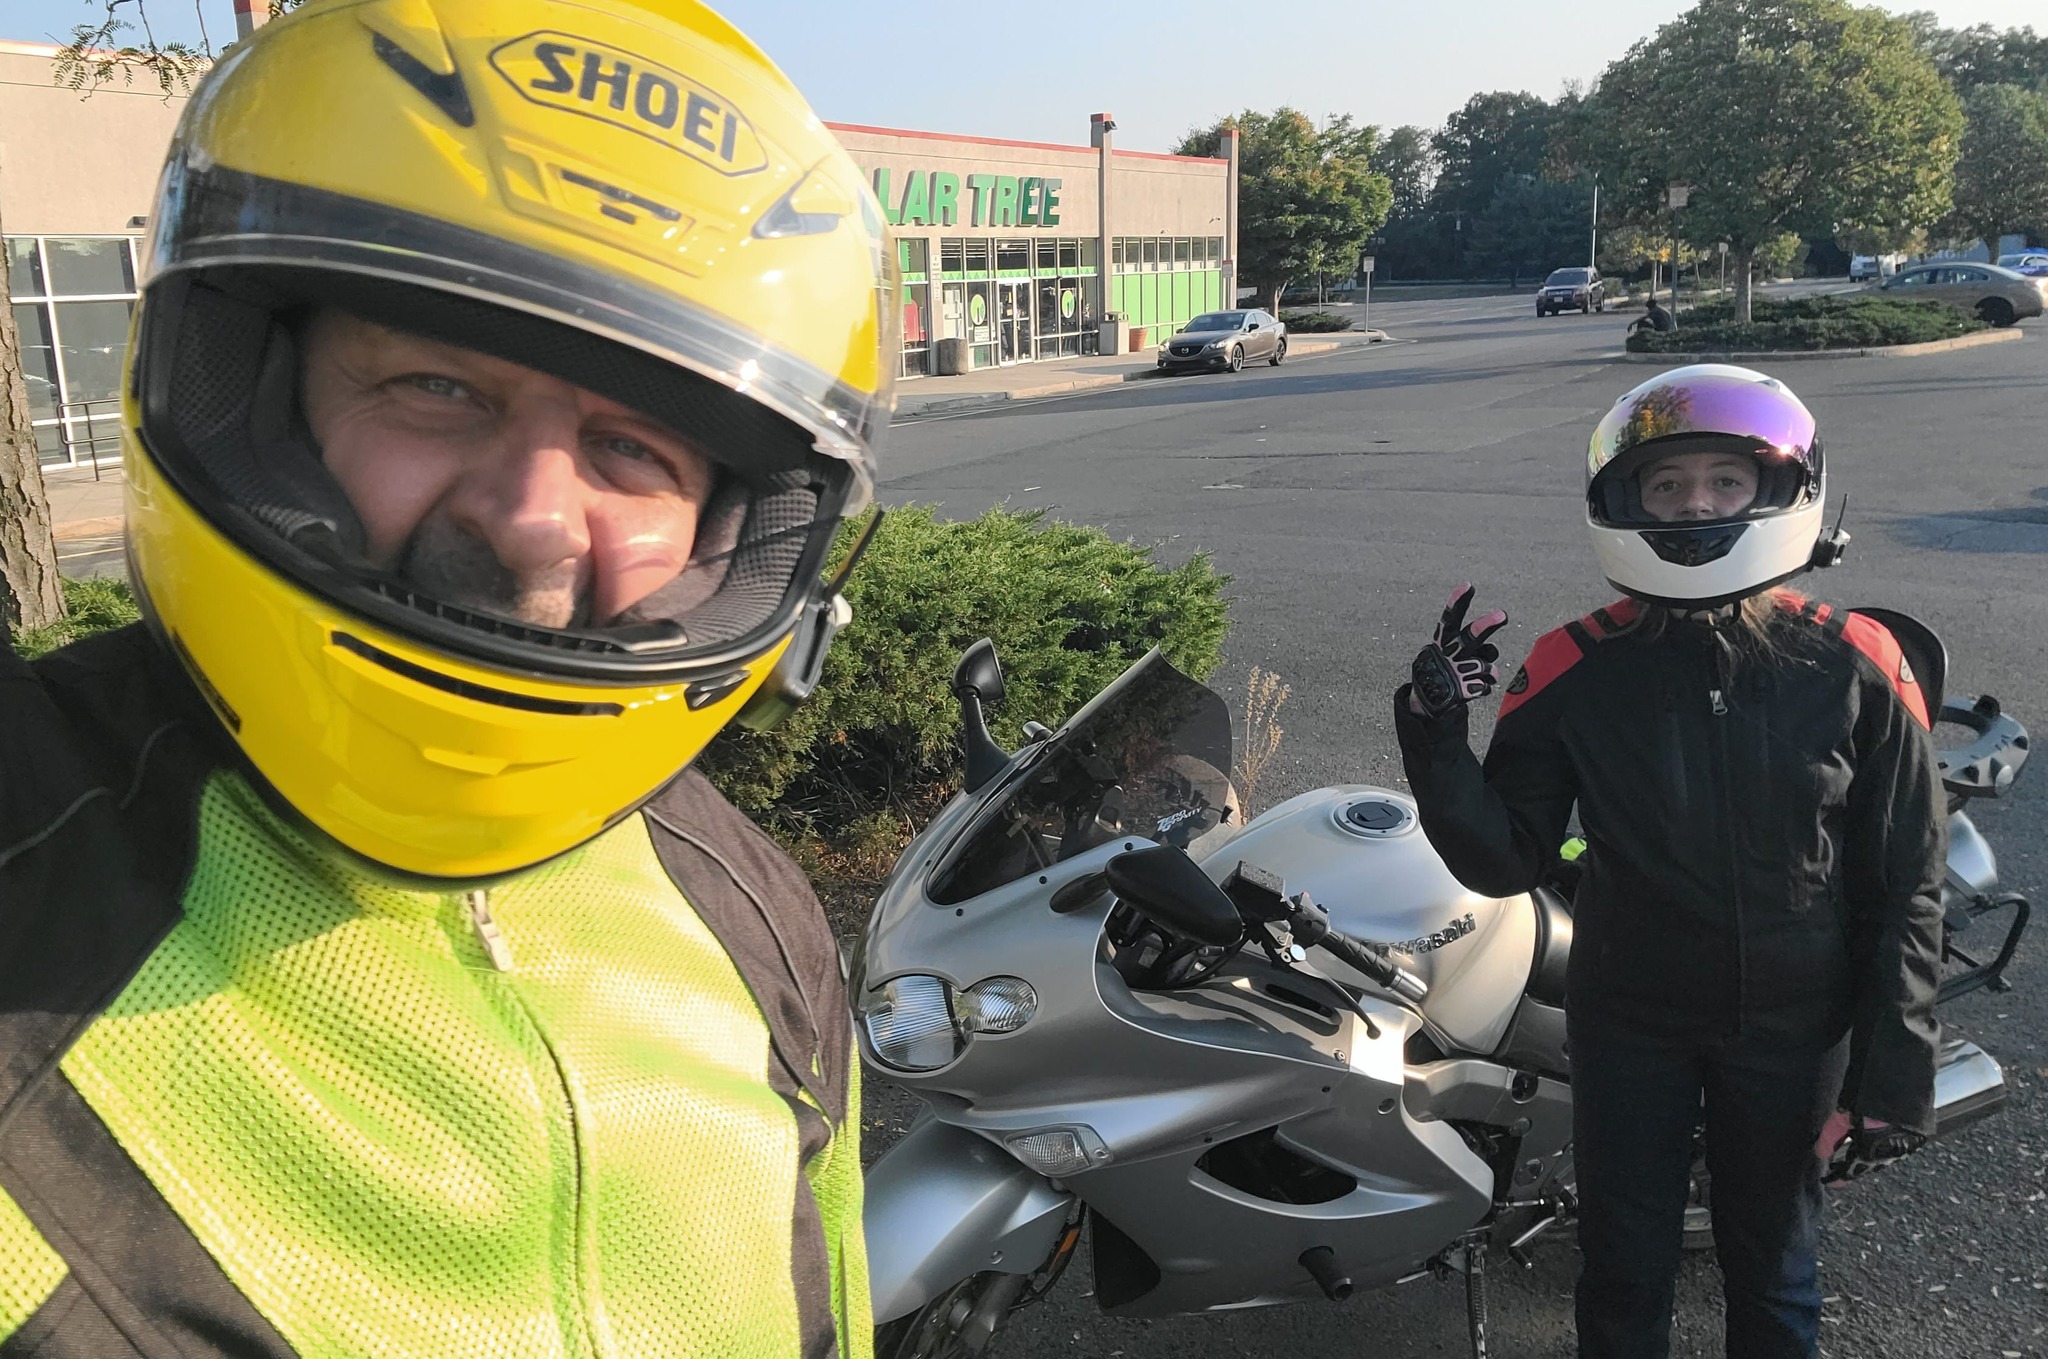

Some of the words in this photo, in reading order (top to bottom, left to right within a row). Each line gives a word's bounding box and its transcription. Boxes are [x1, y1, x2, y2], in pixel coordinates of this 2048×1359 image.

[530, 42, 738, 163] SHOEI
[861, 167, 960, 226] LAR
[967, 173, 1063, 227] TREE
[1364, 911, 1477, 957] awasaki
